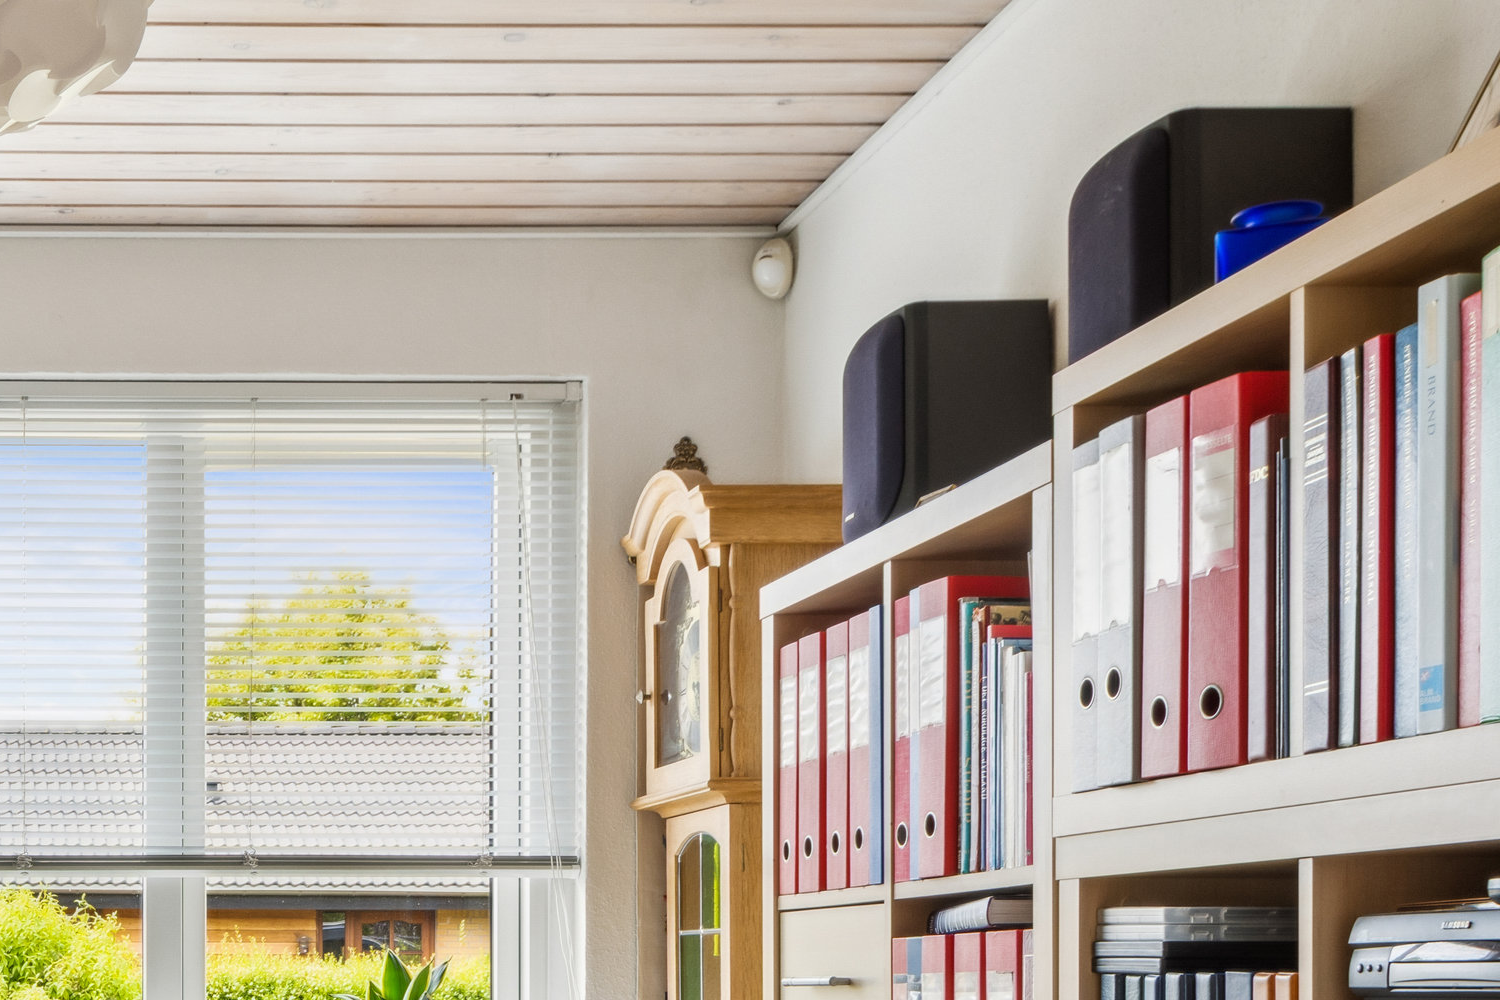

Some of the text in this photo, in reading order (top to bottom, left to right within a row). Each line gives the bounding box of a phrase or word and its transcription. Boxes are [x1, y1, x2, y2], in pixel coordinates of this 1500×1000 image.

[1367, 353, 1377, 413] STENDERS
[1427, 375, 1437, 436] BRAND
[1441, 920, 1471, 929] SAMSUNG
